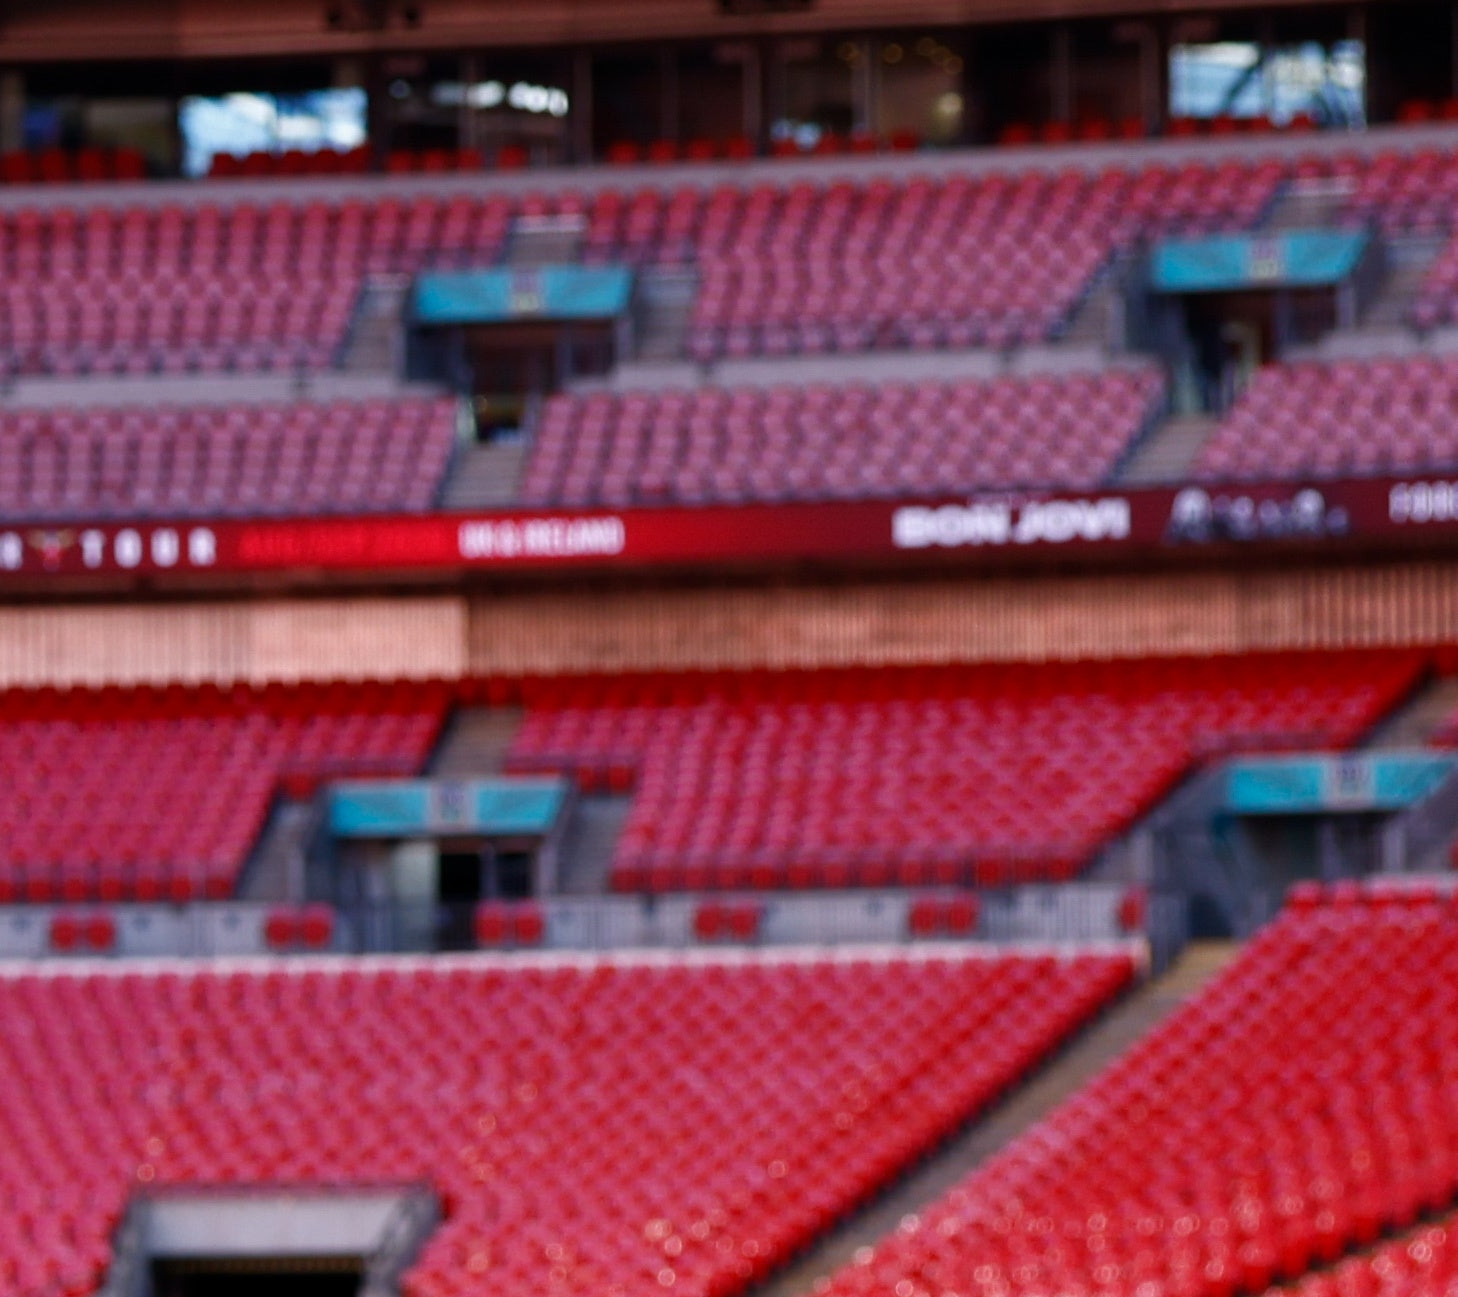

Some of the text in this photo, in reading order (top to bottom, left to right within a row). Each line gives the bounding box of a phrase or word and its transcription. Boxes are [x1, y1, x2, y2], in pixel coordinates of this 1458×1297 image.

[891, 497, 1131, 548] BON JOVI
[79, 527, 217, 569] TOUR
